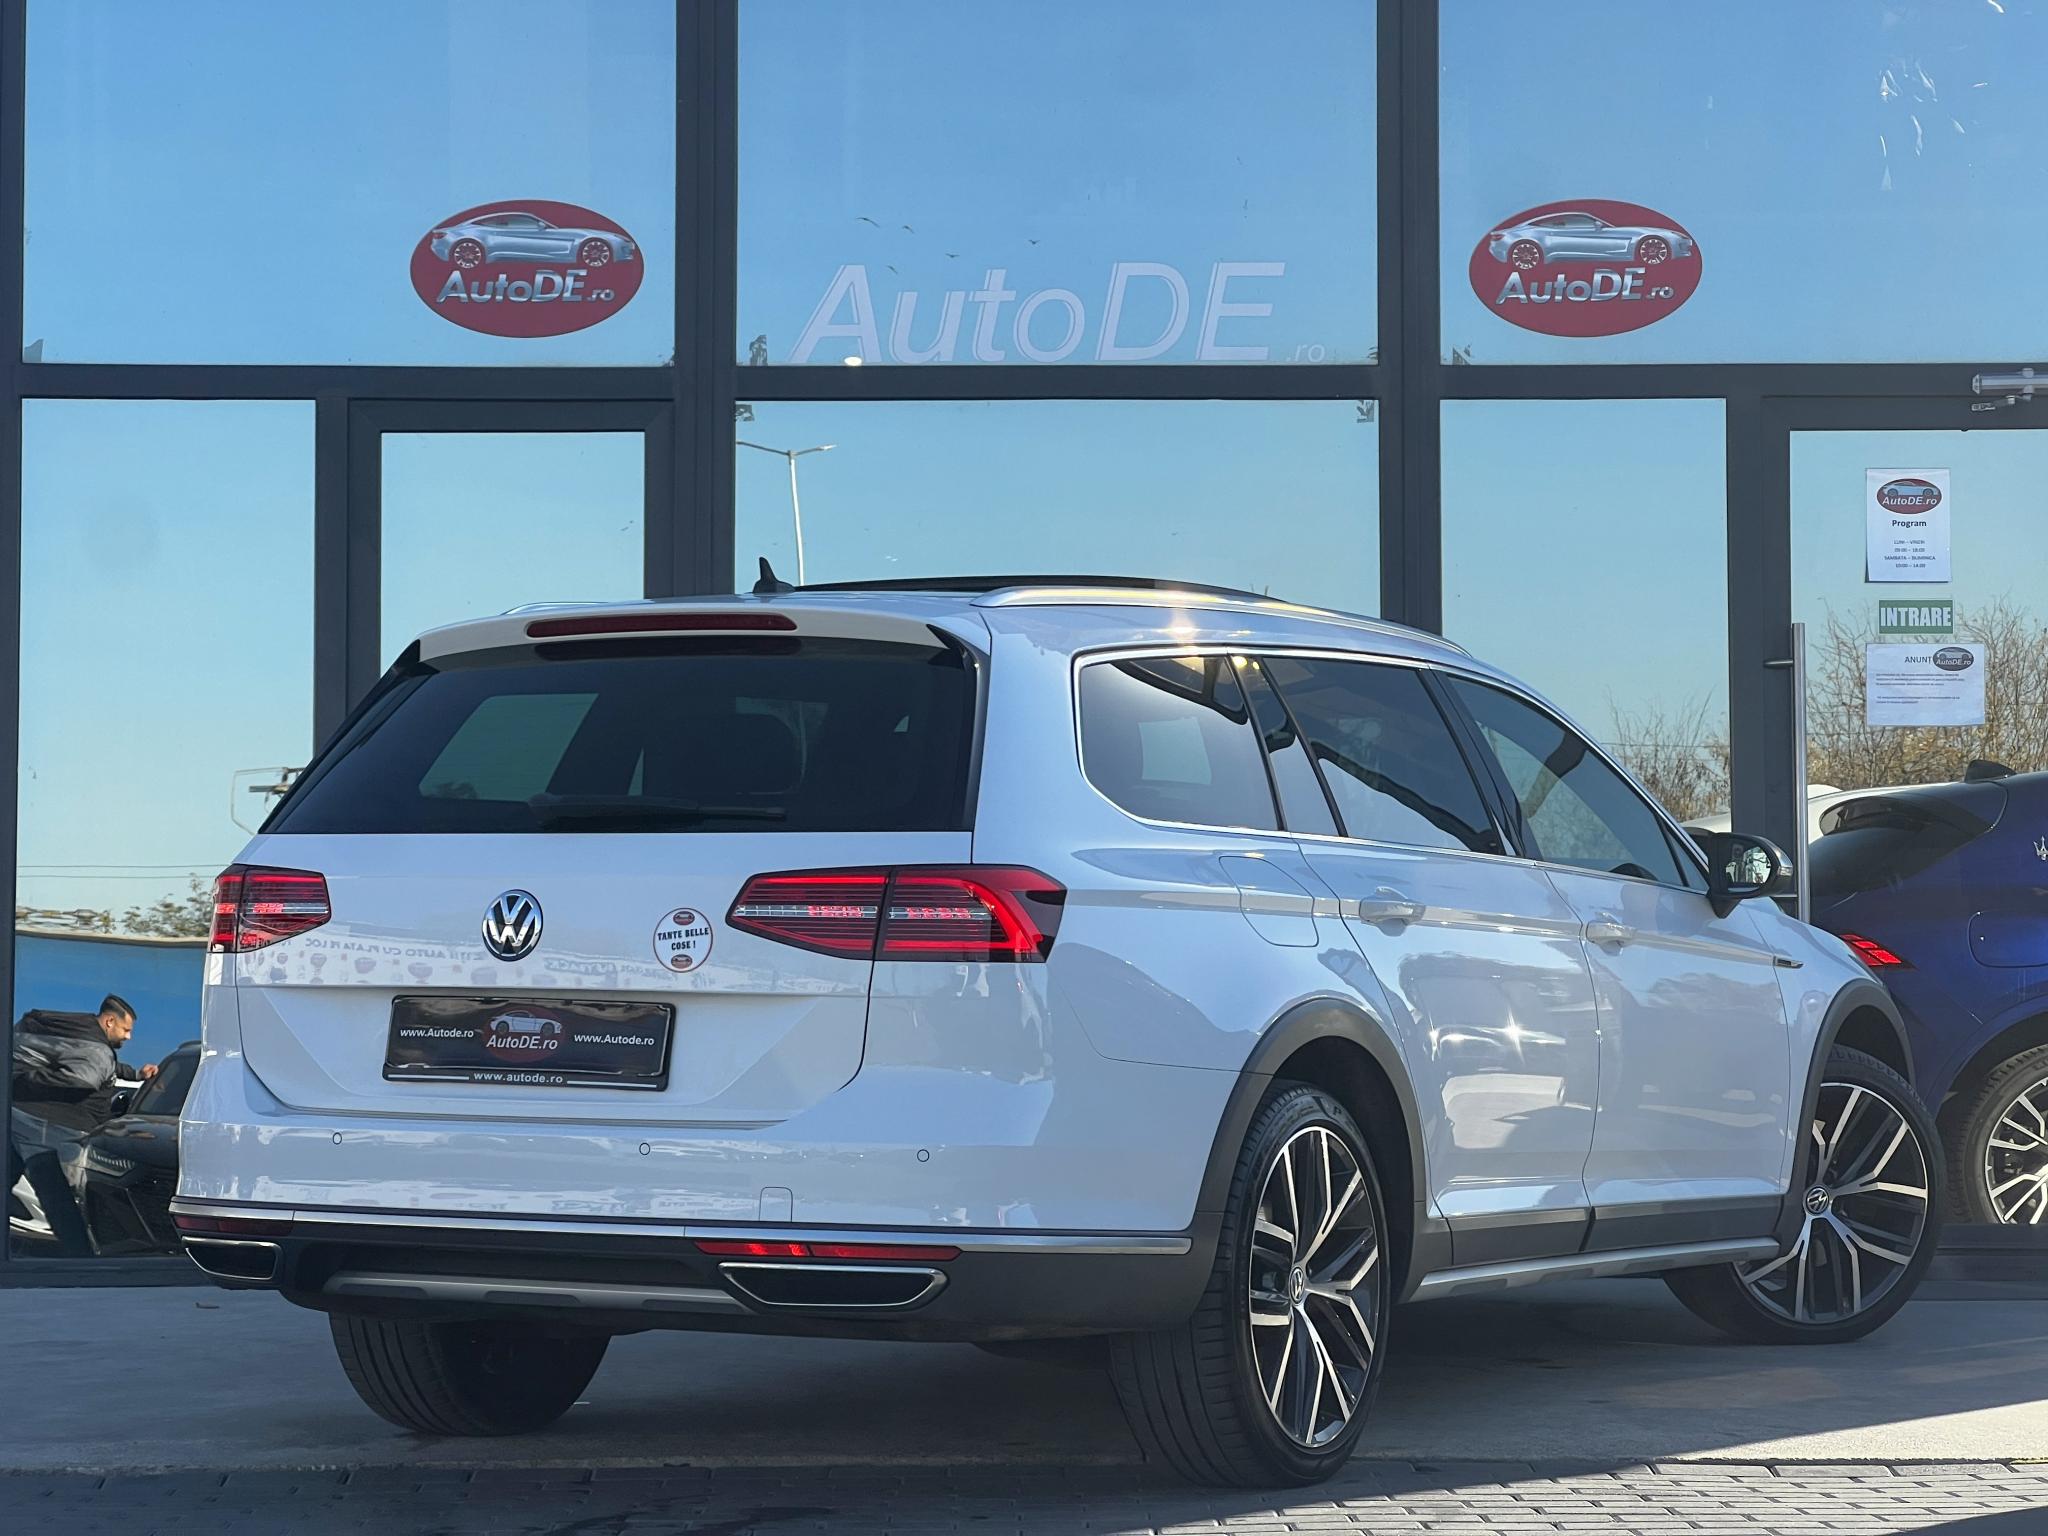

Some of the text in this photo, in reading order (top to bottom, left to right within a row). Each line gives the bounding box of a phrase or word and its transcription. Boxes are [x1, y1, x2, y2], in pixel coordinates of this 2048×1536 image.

[1892, 520, 1927, 528] Program
[1880, 607, 1951, 626] INTRARE
[658, 927, 709, 941] TANTE BELLE
[671, 941, 691, 950] COSE
[400, 1027, 474, 1039] www.Autode.ro
[486, 1035, 558, 1050] AutoDE.ro
[574, 1033, 655, 1046] www.Autode.ro
[473, 1072, 563, 1084] www.autode.ro
